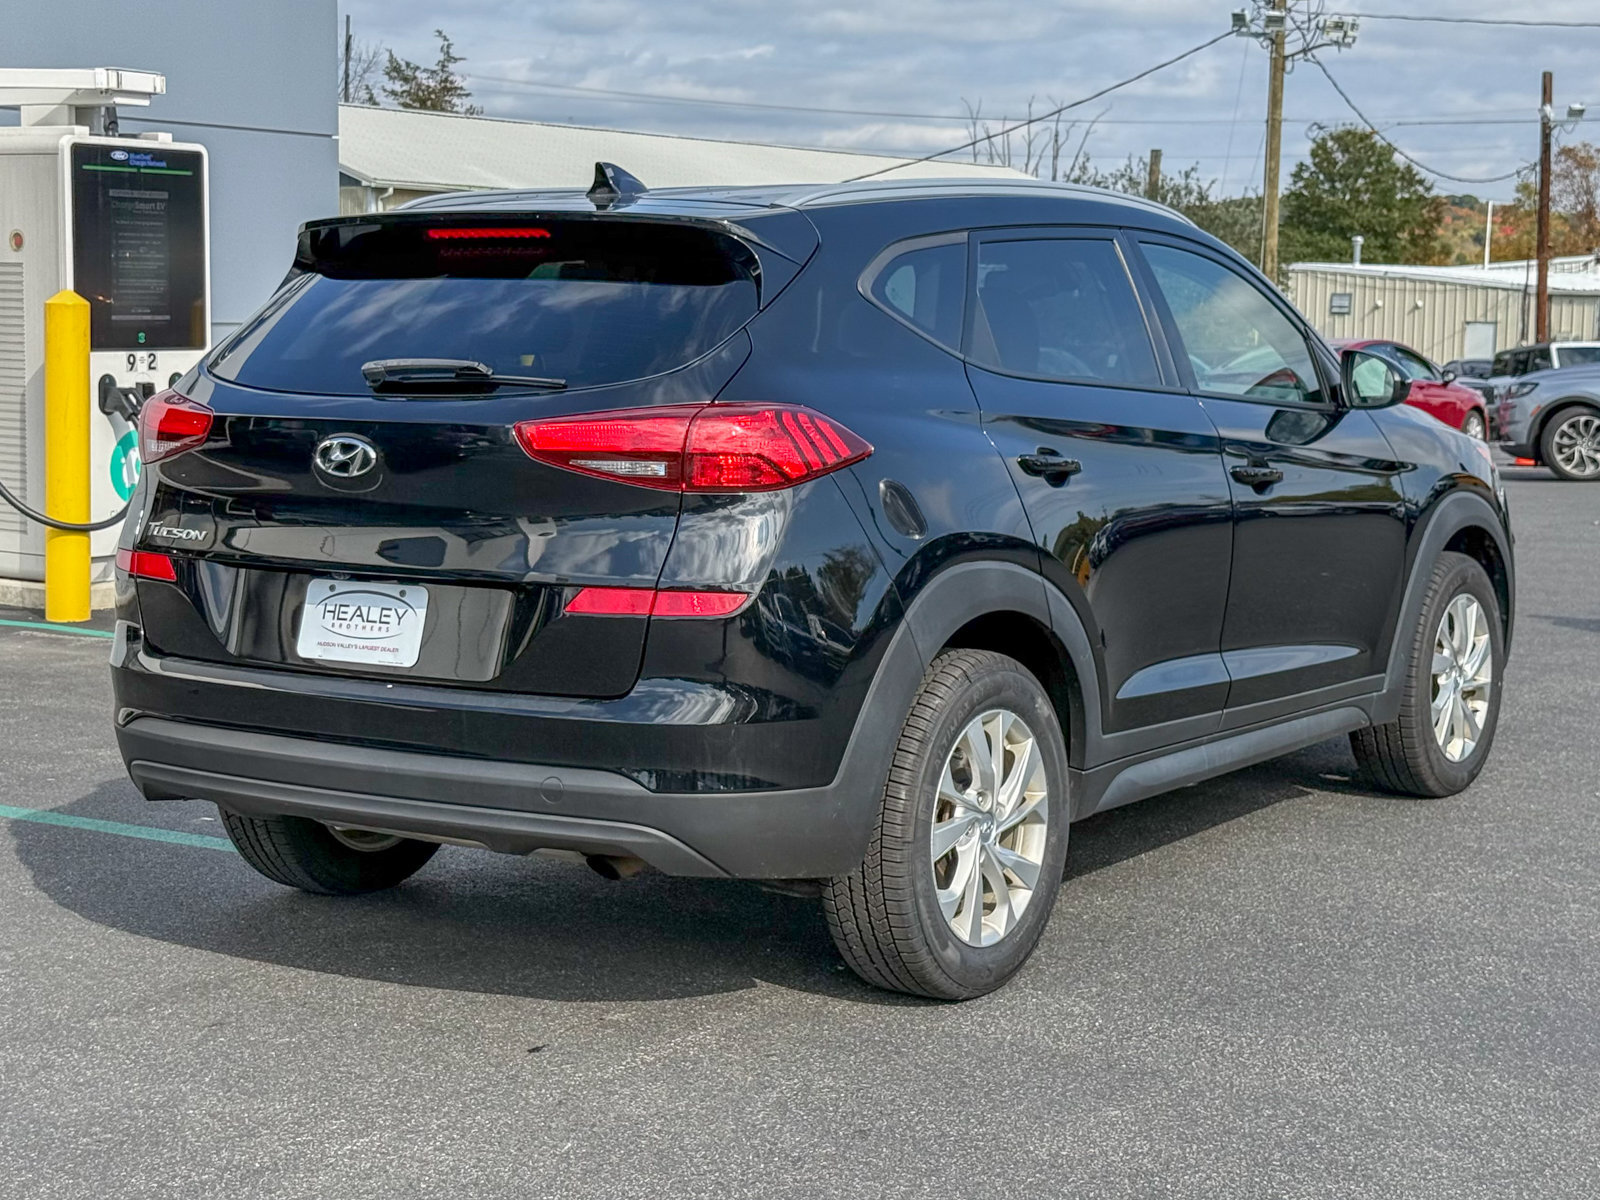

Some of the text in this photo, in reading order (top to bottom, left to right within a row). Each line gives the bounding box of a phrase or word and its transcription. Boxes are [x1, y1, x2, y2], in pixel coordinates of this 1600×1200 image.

[127, 353, 137, 372] 9
[148, 352, 157, 371] 2
[322, 603, 408, 626] HEALEY
[331, 622, 390, 633] BROTHERS
